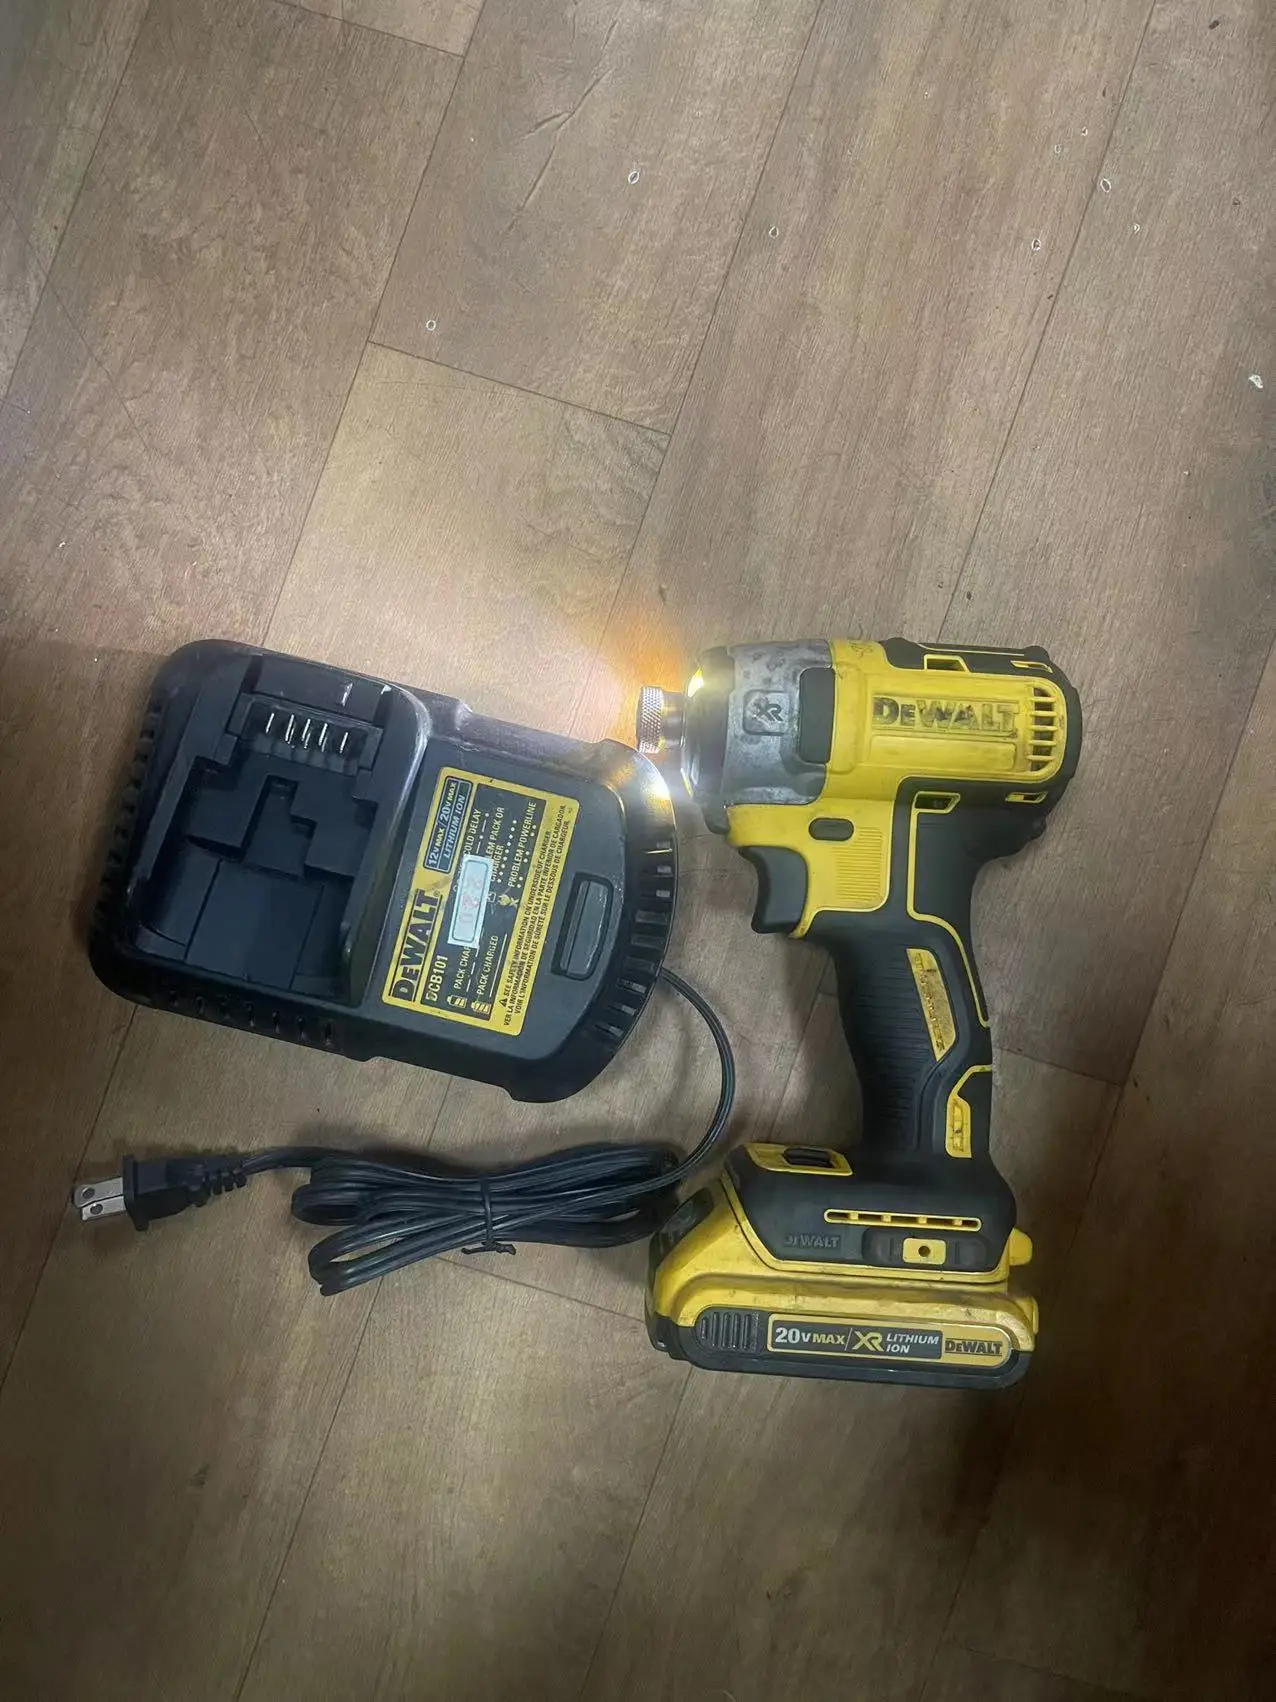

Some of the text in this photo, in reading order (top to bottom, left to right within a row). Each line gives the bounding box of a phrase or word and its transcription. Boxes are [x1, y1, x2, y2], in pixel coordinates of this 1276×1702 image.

[442, 815, 460, 858] LITHIUM
[453, 793, 465, 814] ION
[468, 807, 481, 834] DELAY
[489, 819, 501, 840] PACK
[495, 806, 504, 818] OR
[507, 800, 537, 887] PROBLEM POWERLINE
[425, 954, 448, 1001] DCB101
[452, 967, 465, 989] PACK
[476, 933, 499, 995] PACK CHARGED
[852, 1331, 884, 1351] XR
[885, 1343, 910, 1354] ION
[886, 1332, 940, 1345] LITHIUM
